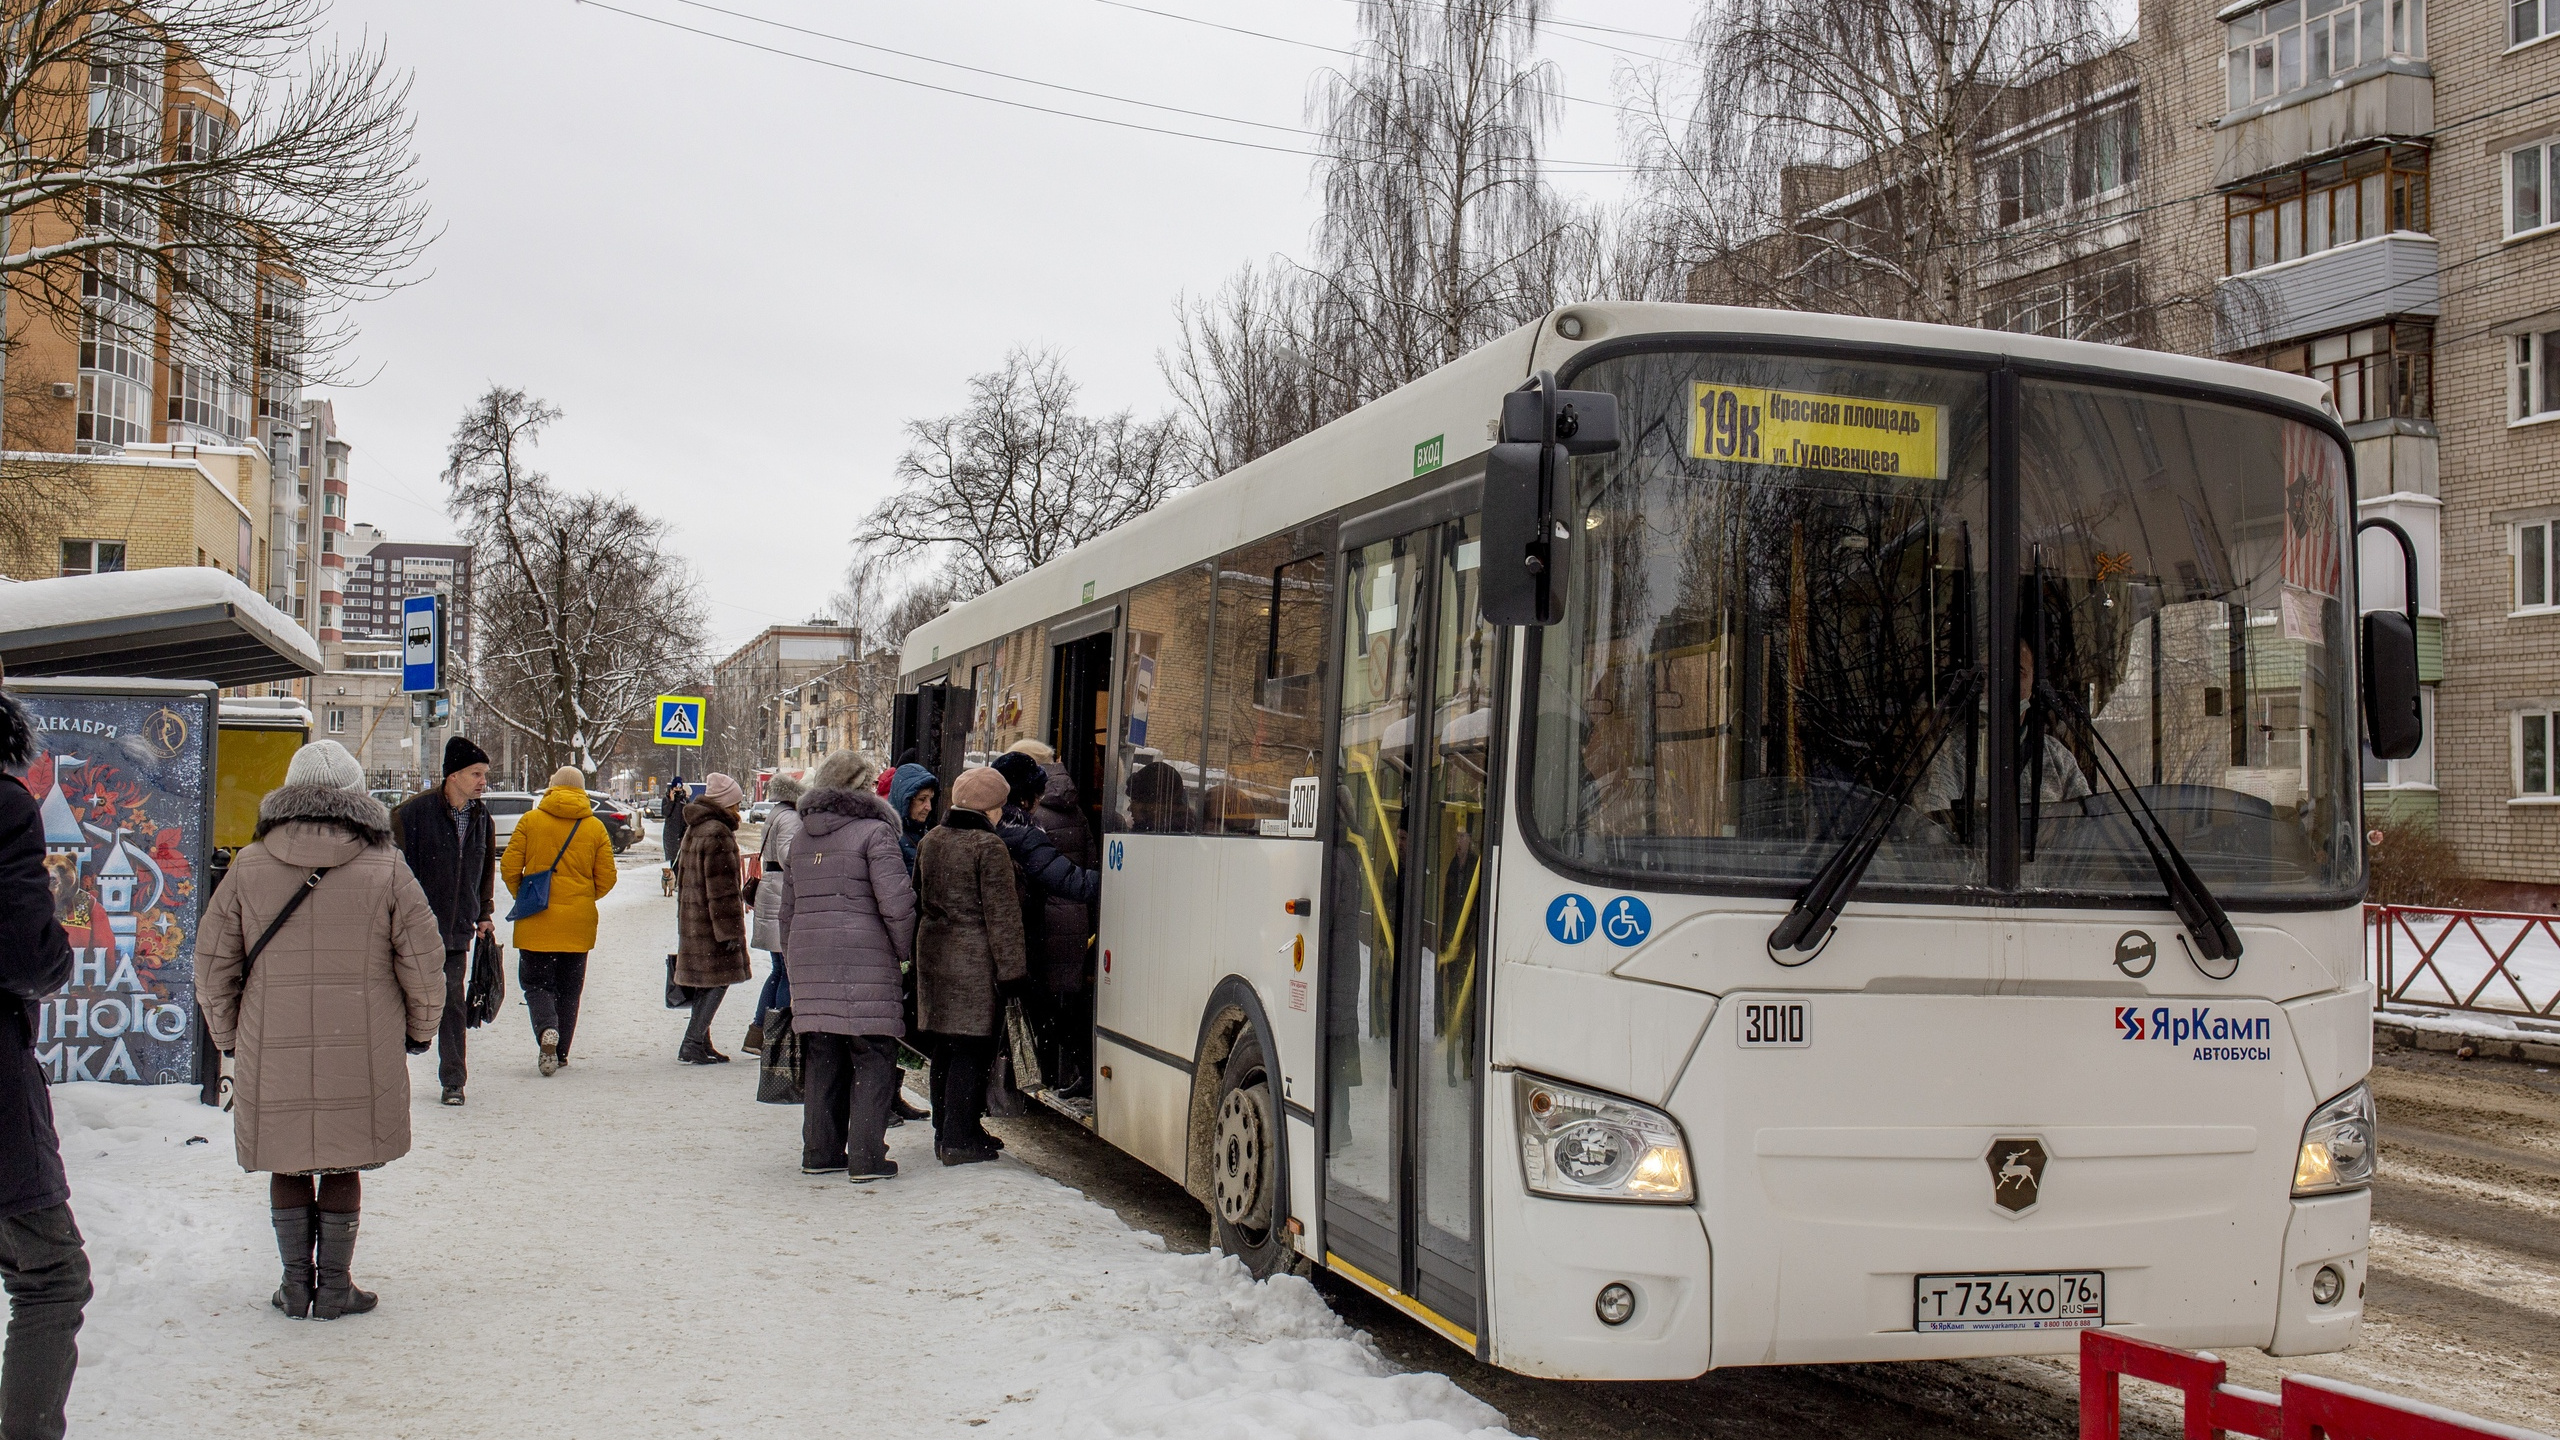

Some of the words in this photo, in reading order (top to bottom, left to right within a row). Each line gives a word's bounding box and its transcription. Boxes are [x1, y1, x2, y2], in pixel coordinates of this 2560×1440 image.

[1770, 393, 1840, 425] Красная
[1843, 405, 1921, 436] площадь
[1417, 441, 1440, 468] ВХОД
[1772, 446, 1789, 464] ул.
[1792, 439, 1900, 474] Гудованцева
[36, 717, 118, 739] ДЕКАБРЯ
[1292, 785, 1316, 829] 3010
[1746, 1005, 1804, 1042] 3010
[2151, 1007, 2270, 1046] ЯрКамп
[2193, 1047, 2271, 1061] АВТОБУСЫ
[2063, 1278, 2091, 1303] 76
[2061, 1304, 2083, 1314] RUS
[1938, 1322, 1965, 1331] ЯрКамп
[1972, 1321, 2026, 1330] www.yarkamp.ru
